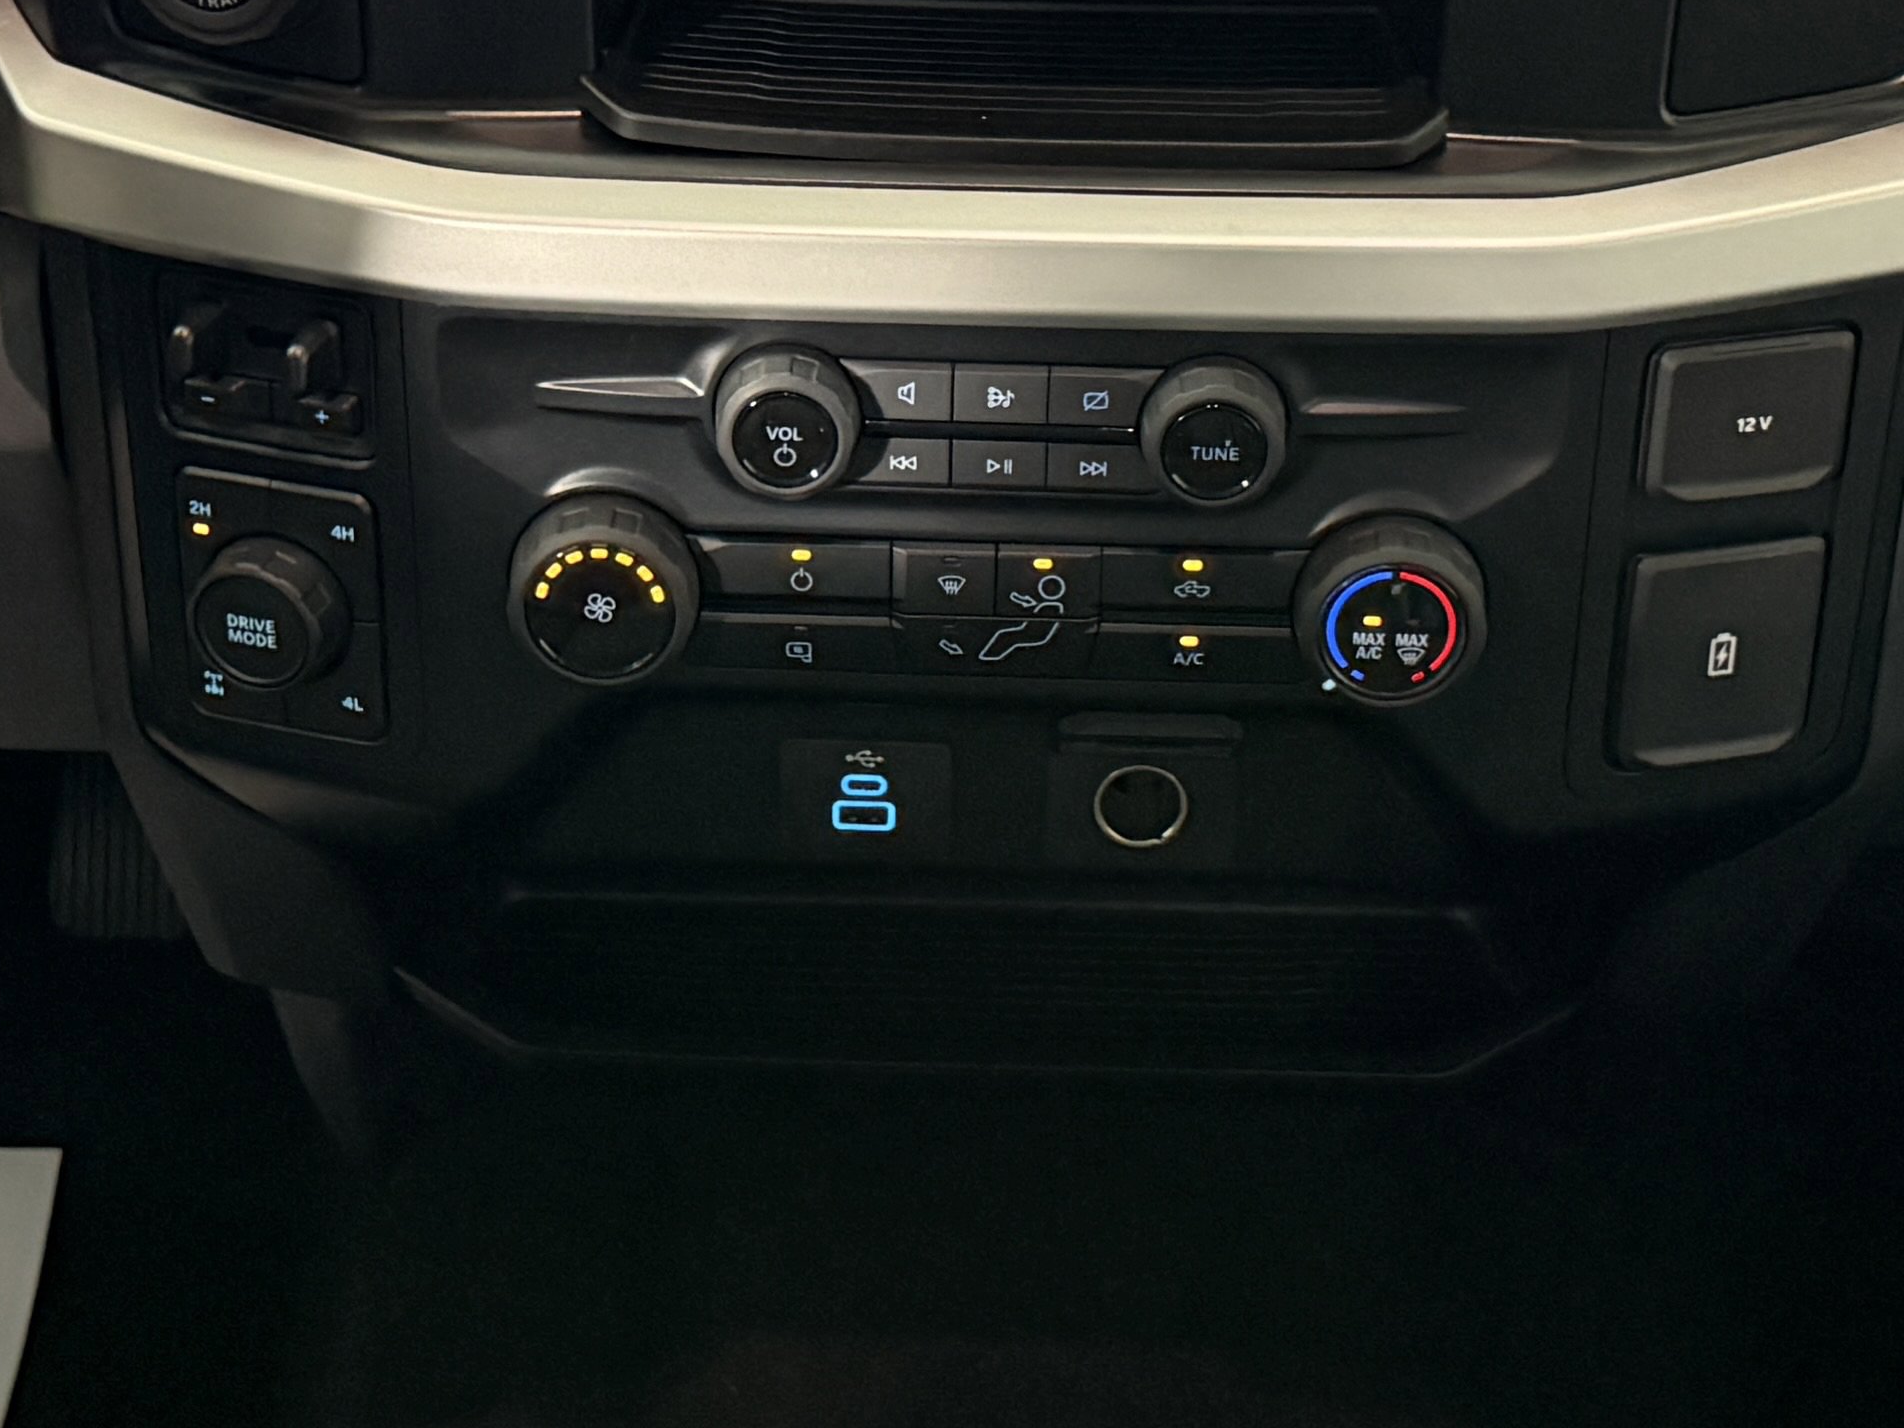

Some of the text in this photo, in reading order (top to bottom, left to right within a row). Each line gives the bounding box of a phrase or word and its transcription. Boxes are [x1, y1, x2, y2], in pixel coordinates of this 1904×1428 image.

[765, 425, 804, 441] VOL
[1736, 417, 1757, 433] 12
[1190, 445, 1240, 461] TUNE
[188, 499, 212, 518] 2H
[330, 523, 356, 543] 4H
[226, 612, 276, 635] DRIVE
[227, 628, 278, 650] MODE
[1352, 632, 1386, 646] MAX
[1395, 632, 1429, 648] MAX
[1173, 652, 1205, 666] A/C
[1354, 645, 1383, 660] A/C
[341, 695, 364, 713] 4L
